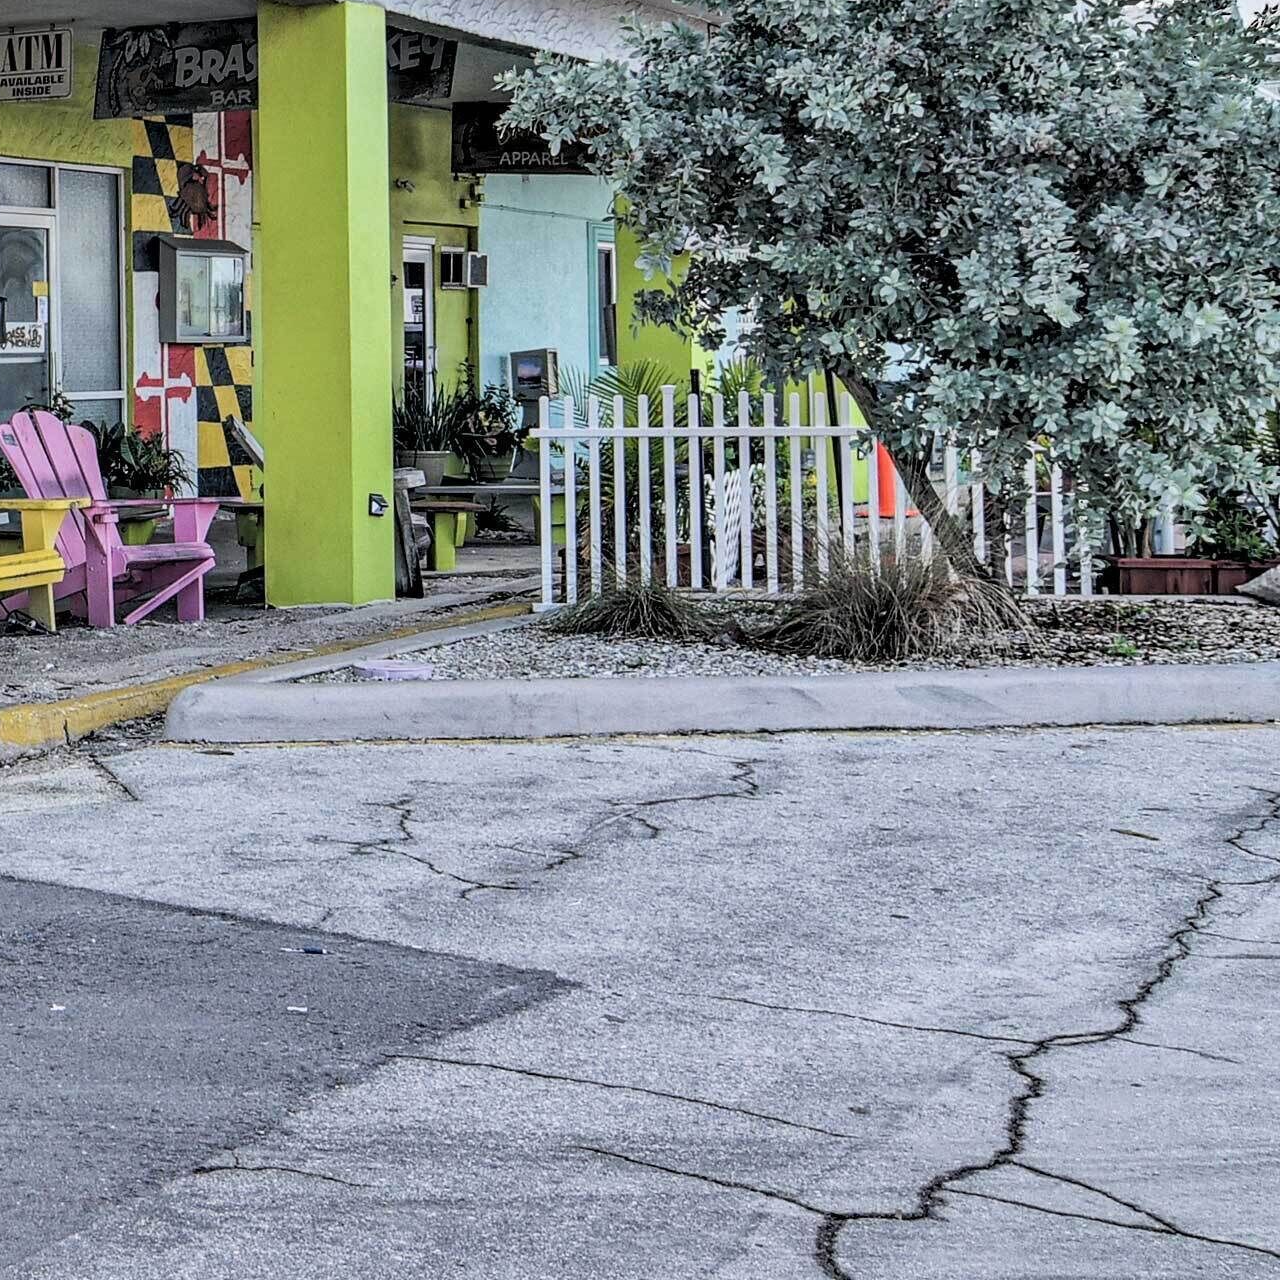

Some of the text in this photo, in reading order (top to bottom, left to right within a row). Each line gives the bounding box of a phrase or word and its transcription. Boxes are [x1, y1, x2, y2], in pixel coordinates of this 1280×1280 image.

[0, 33, 64, 73] ATM
[388, 33, 447, 71] KEY
[174, 42, 257, 88] BRAS
[0, 74, 65, 88] AVAILABLE
[12, 85, 52, 97] INSIDE
[210, 89, 253, 106] BAR
[499, 150, 569, 167] APPAREL
